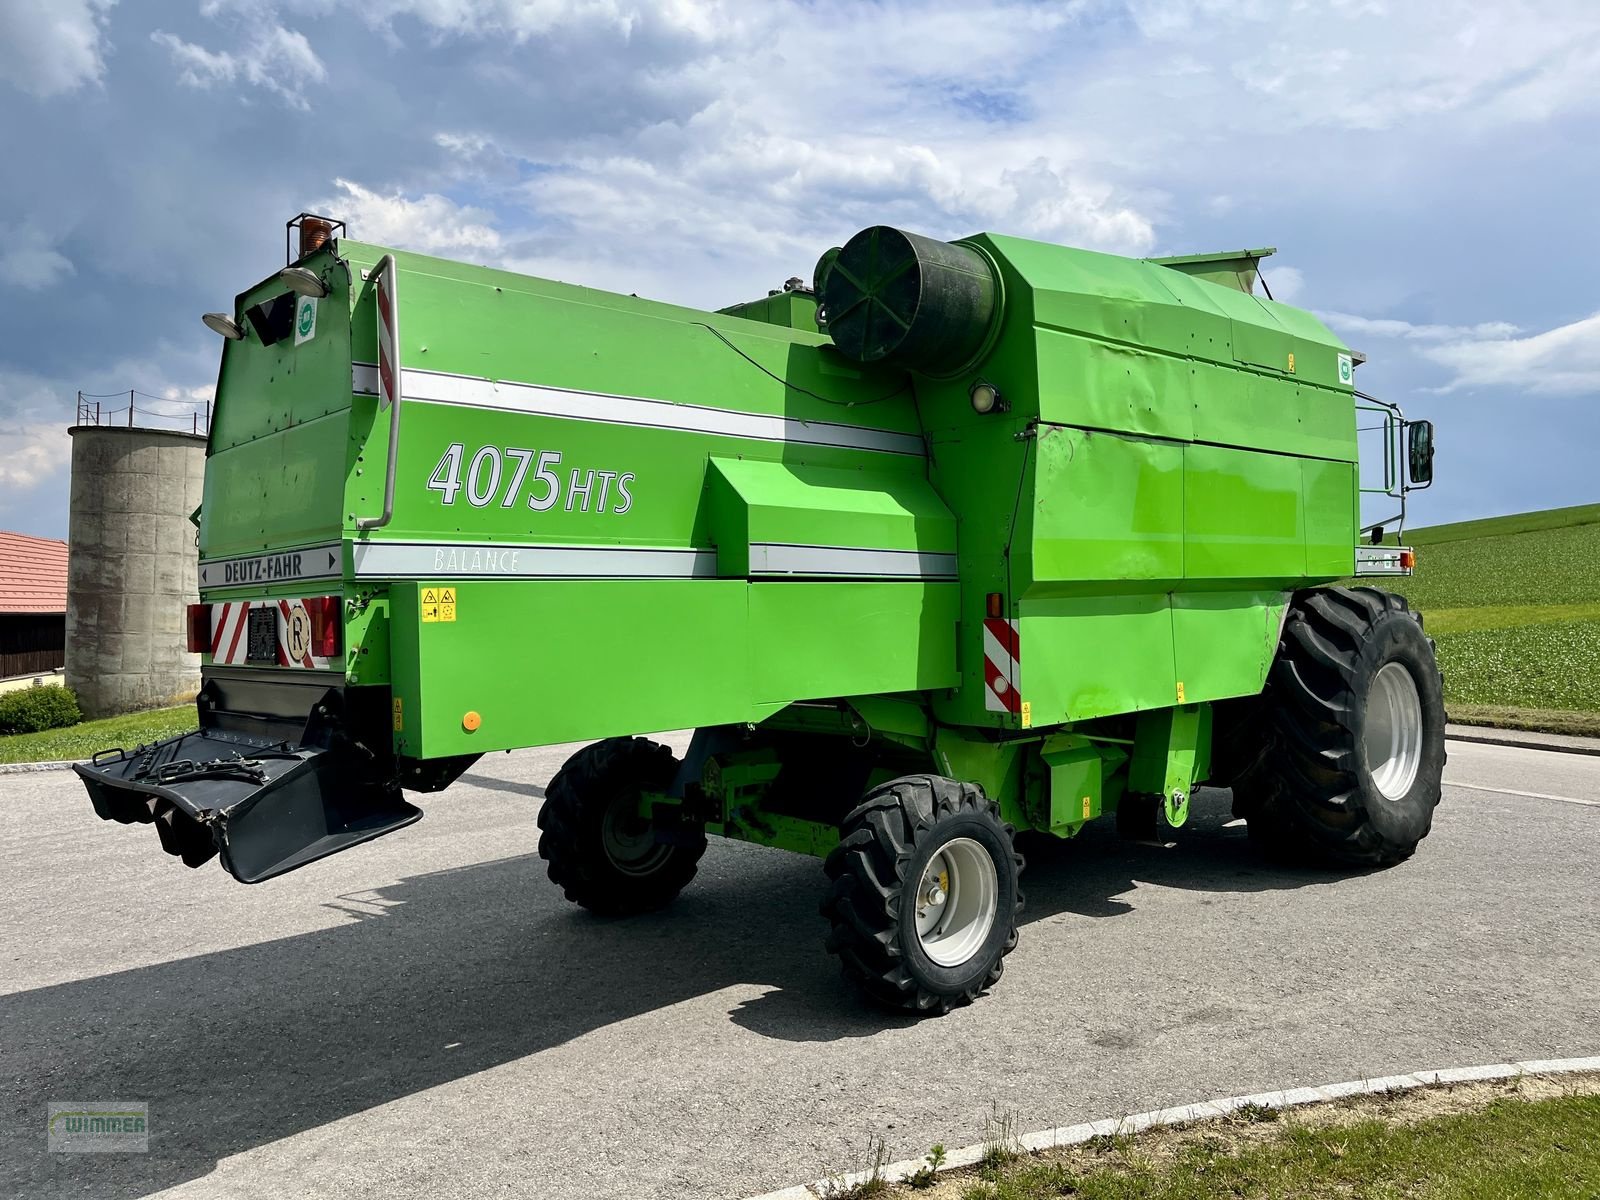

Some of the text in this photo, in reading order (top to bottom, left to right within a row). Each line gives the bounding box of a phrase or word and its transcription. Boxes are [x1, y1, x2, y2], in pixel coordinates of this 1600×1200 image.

[427, 443, 635, 514] 4075 HTS
[225, 553, 302, 582] DEUTZ-FAHR
[433, 549, 520, 572] BALANCE
[292, 616, 303, 651] R
